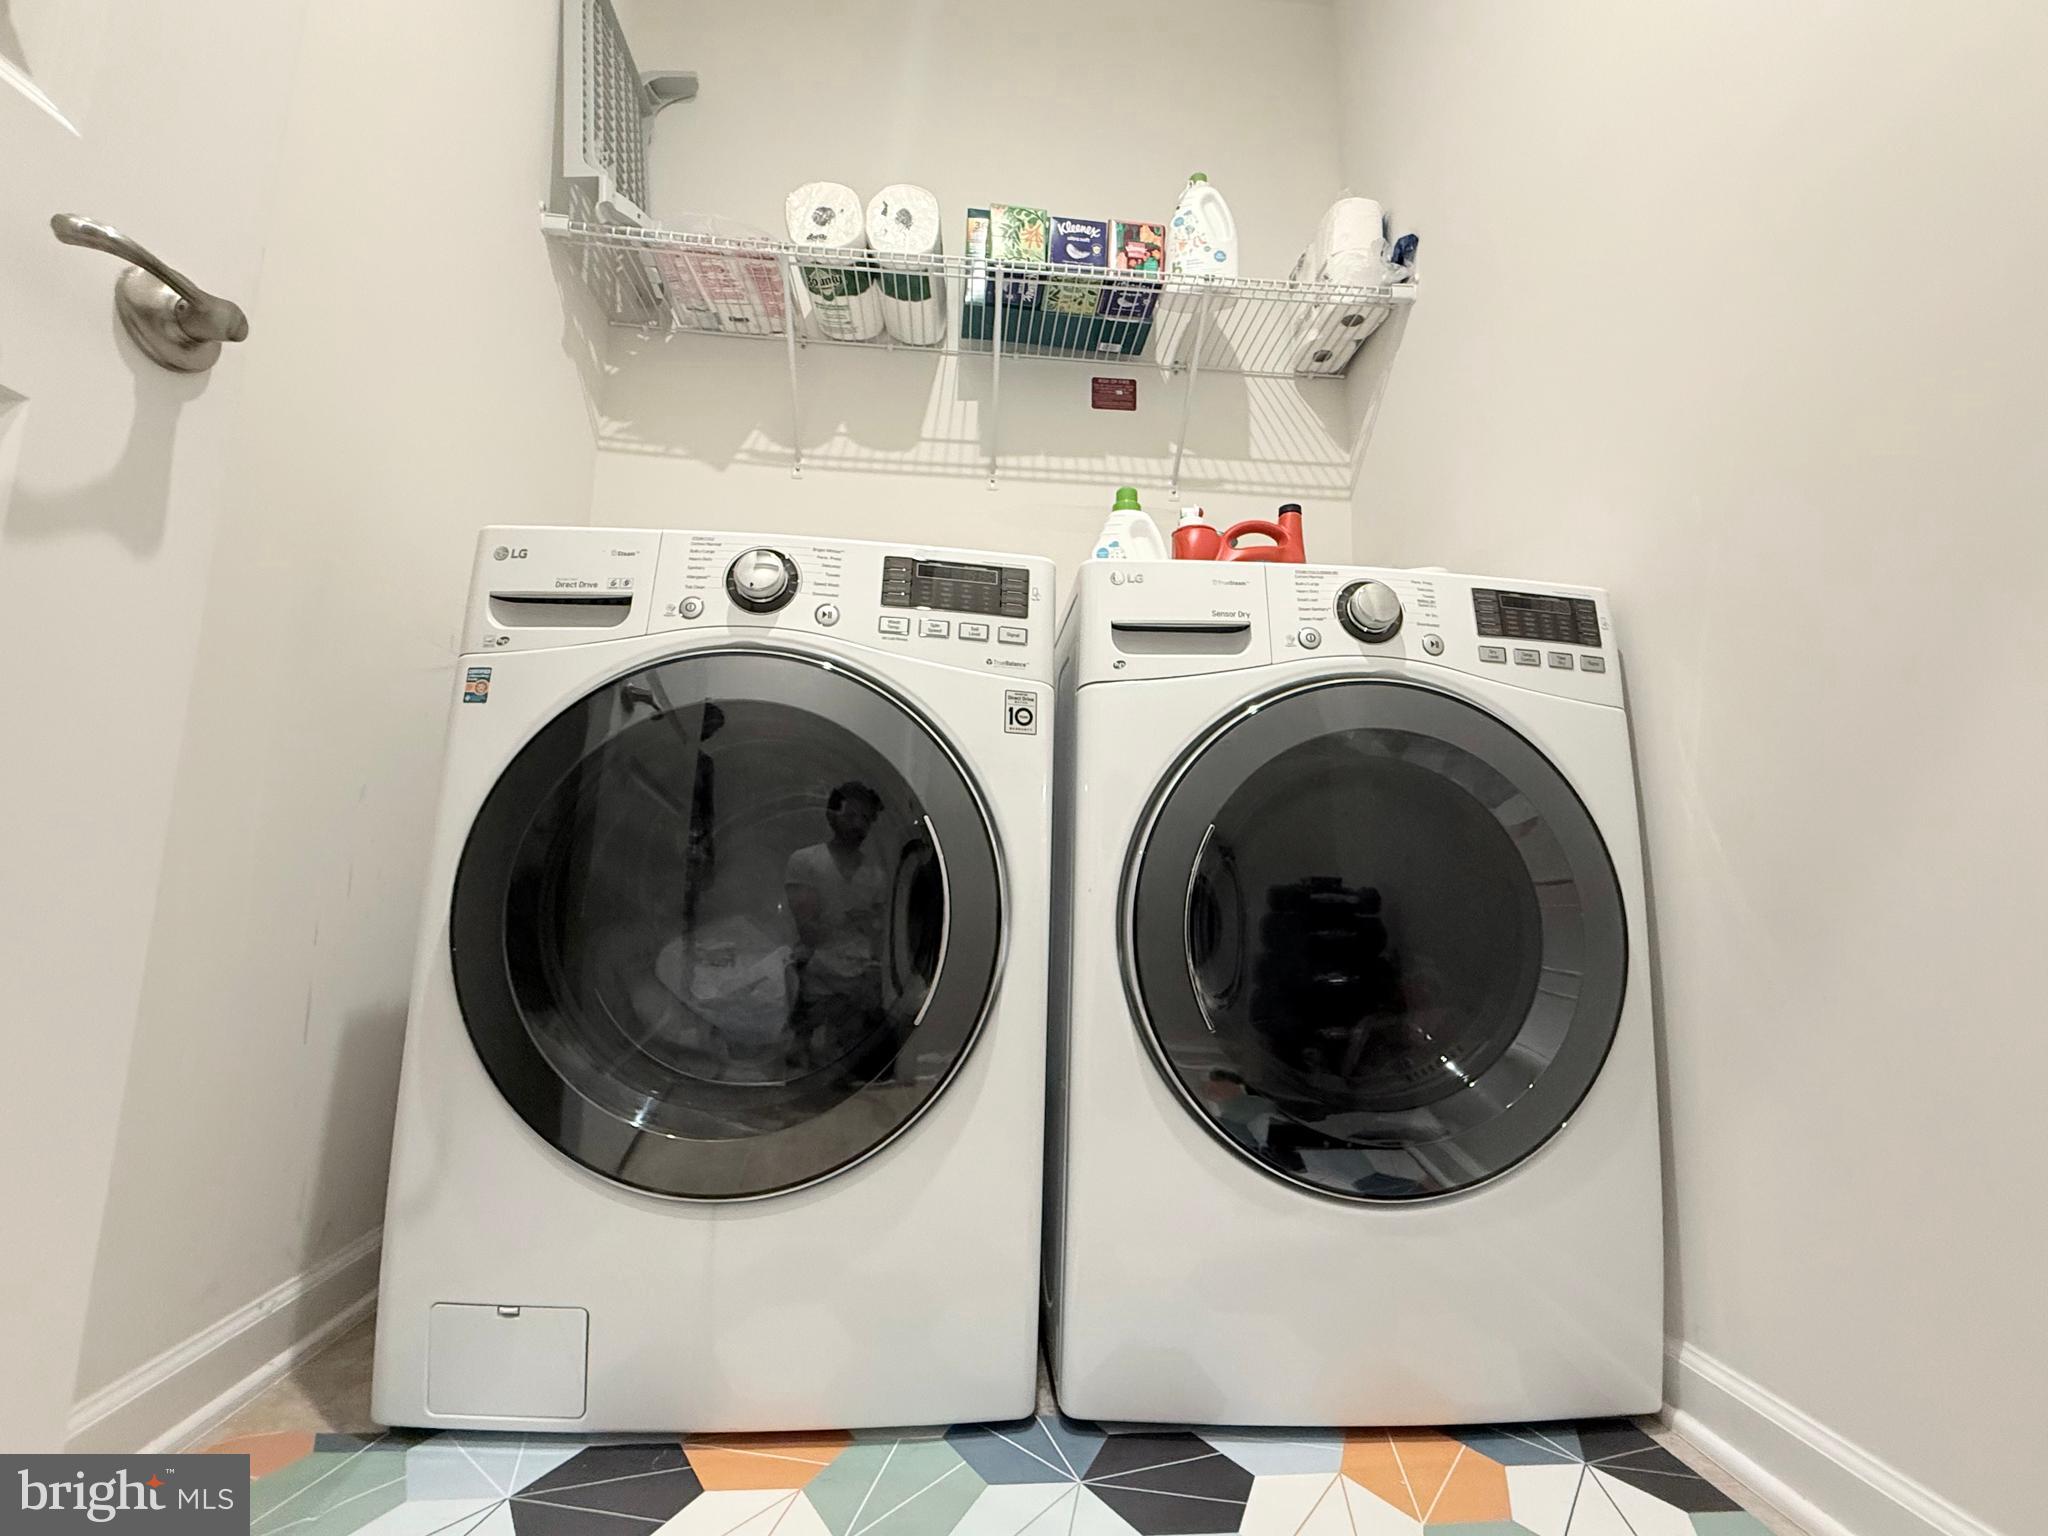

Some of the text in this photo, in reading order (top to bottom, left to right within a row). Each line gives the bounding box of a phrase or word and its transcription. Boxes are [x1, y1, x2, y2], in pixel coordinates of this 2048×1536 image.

[1057, 221, 1101, 239] Kleenex
[511, 549, 528, 559] LG
[1127, 574, 1144, 584] LG
[1211, 610, 1250, 619] Sensor Dry
[1008, 707, 1033, 727] 10
